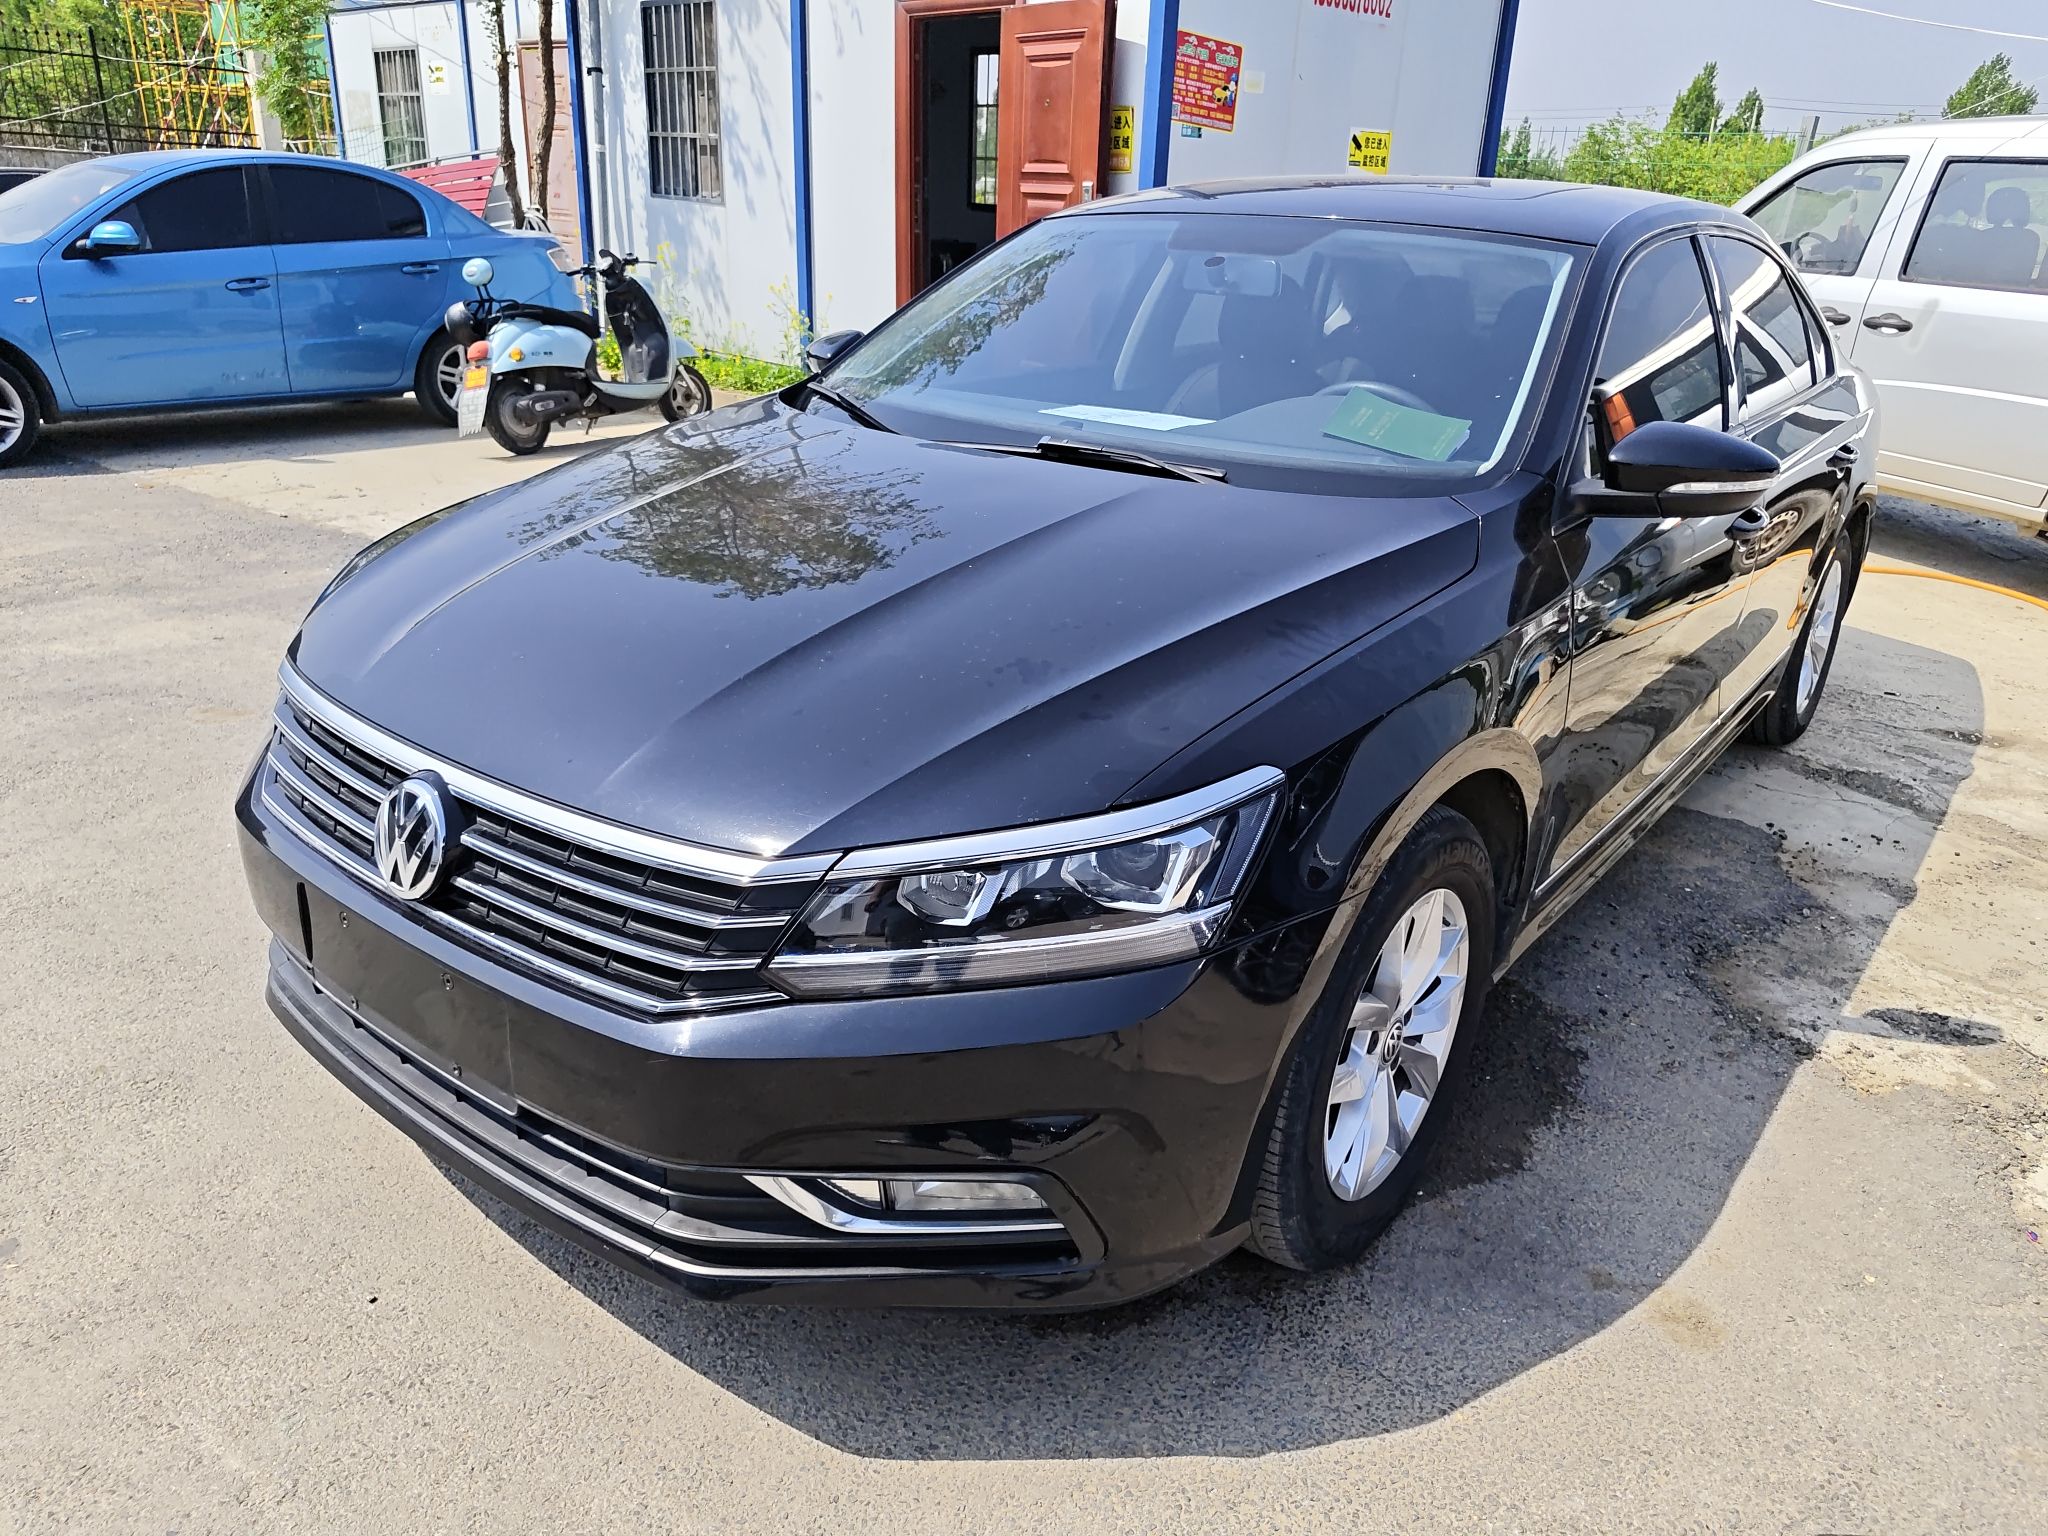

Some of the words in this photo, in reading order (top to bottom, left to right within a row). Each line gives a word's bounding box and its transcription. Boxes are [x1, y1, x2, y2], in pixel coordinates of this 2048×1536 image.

[1111, 115, 1130, 129] 进入
[1110, 136, 1130, 150] 区域
[1363, 136, 1388, 150] 您已进入
[1362, 154, 1387, 168] 监控区域
